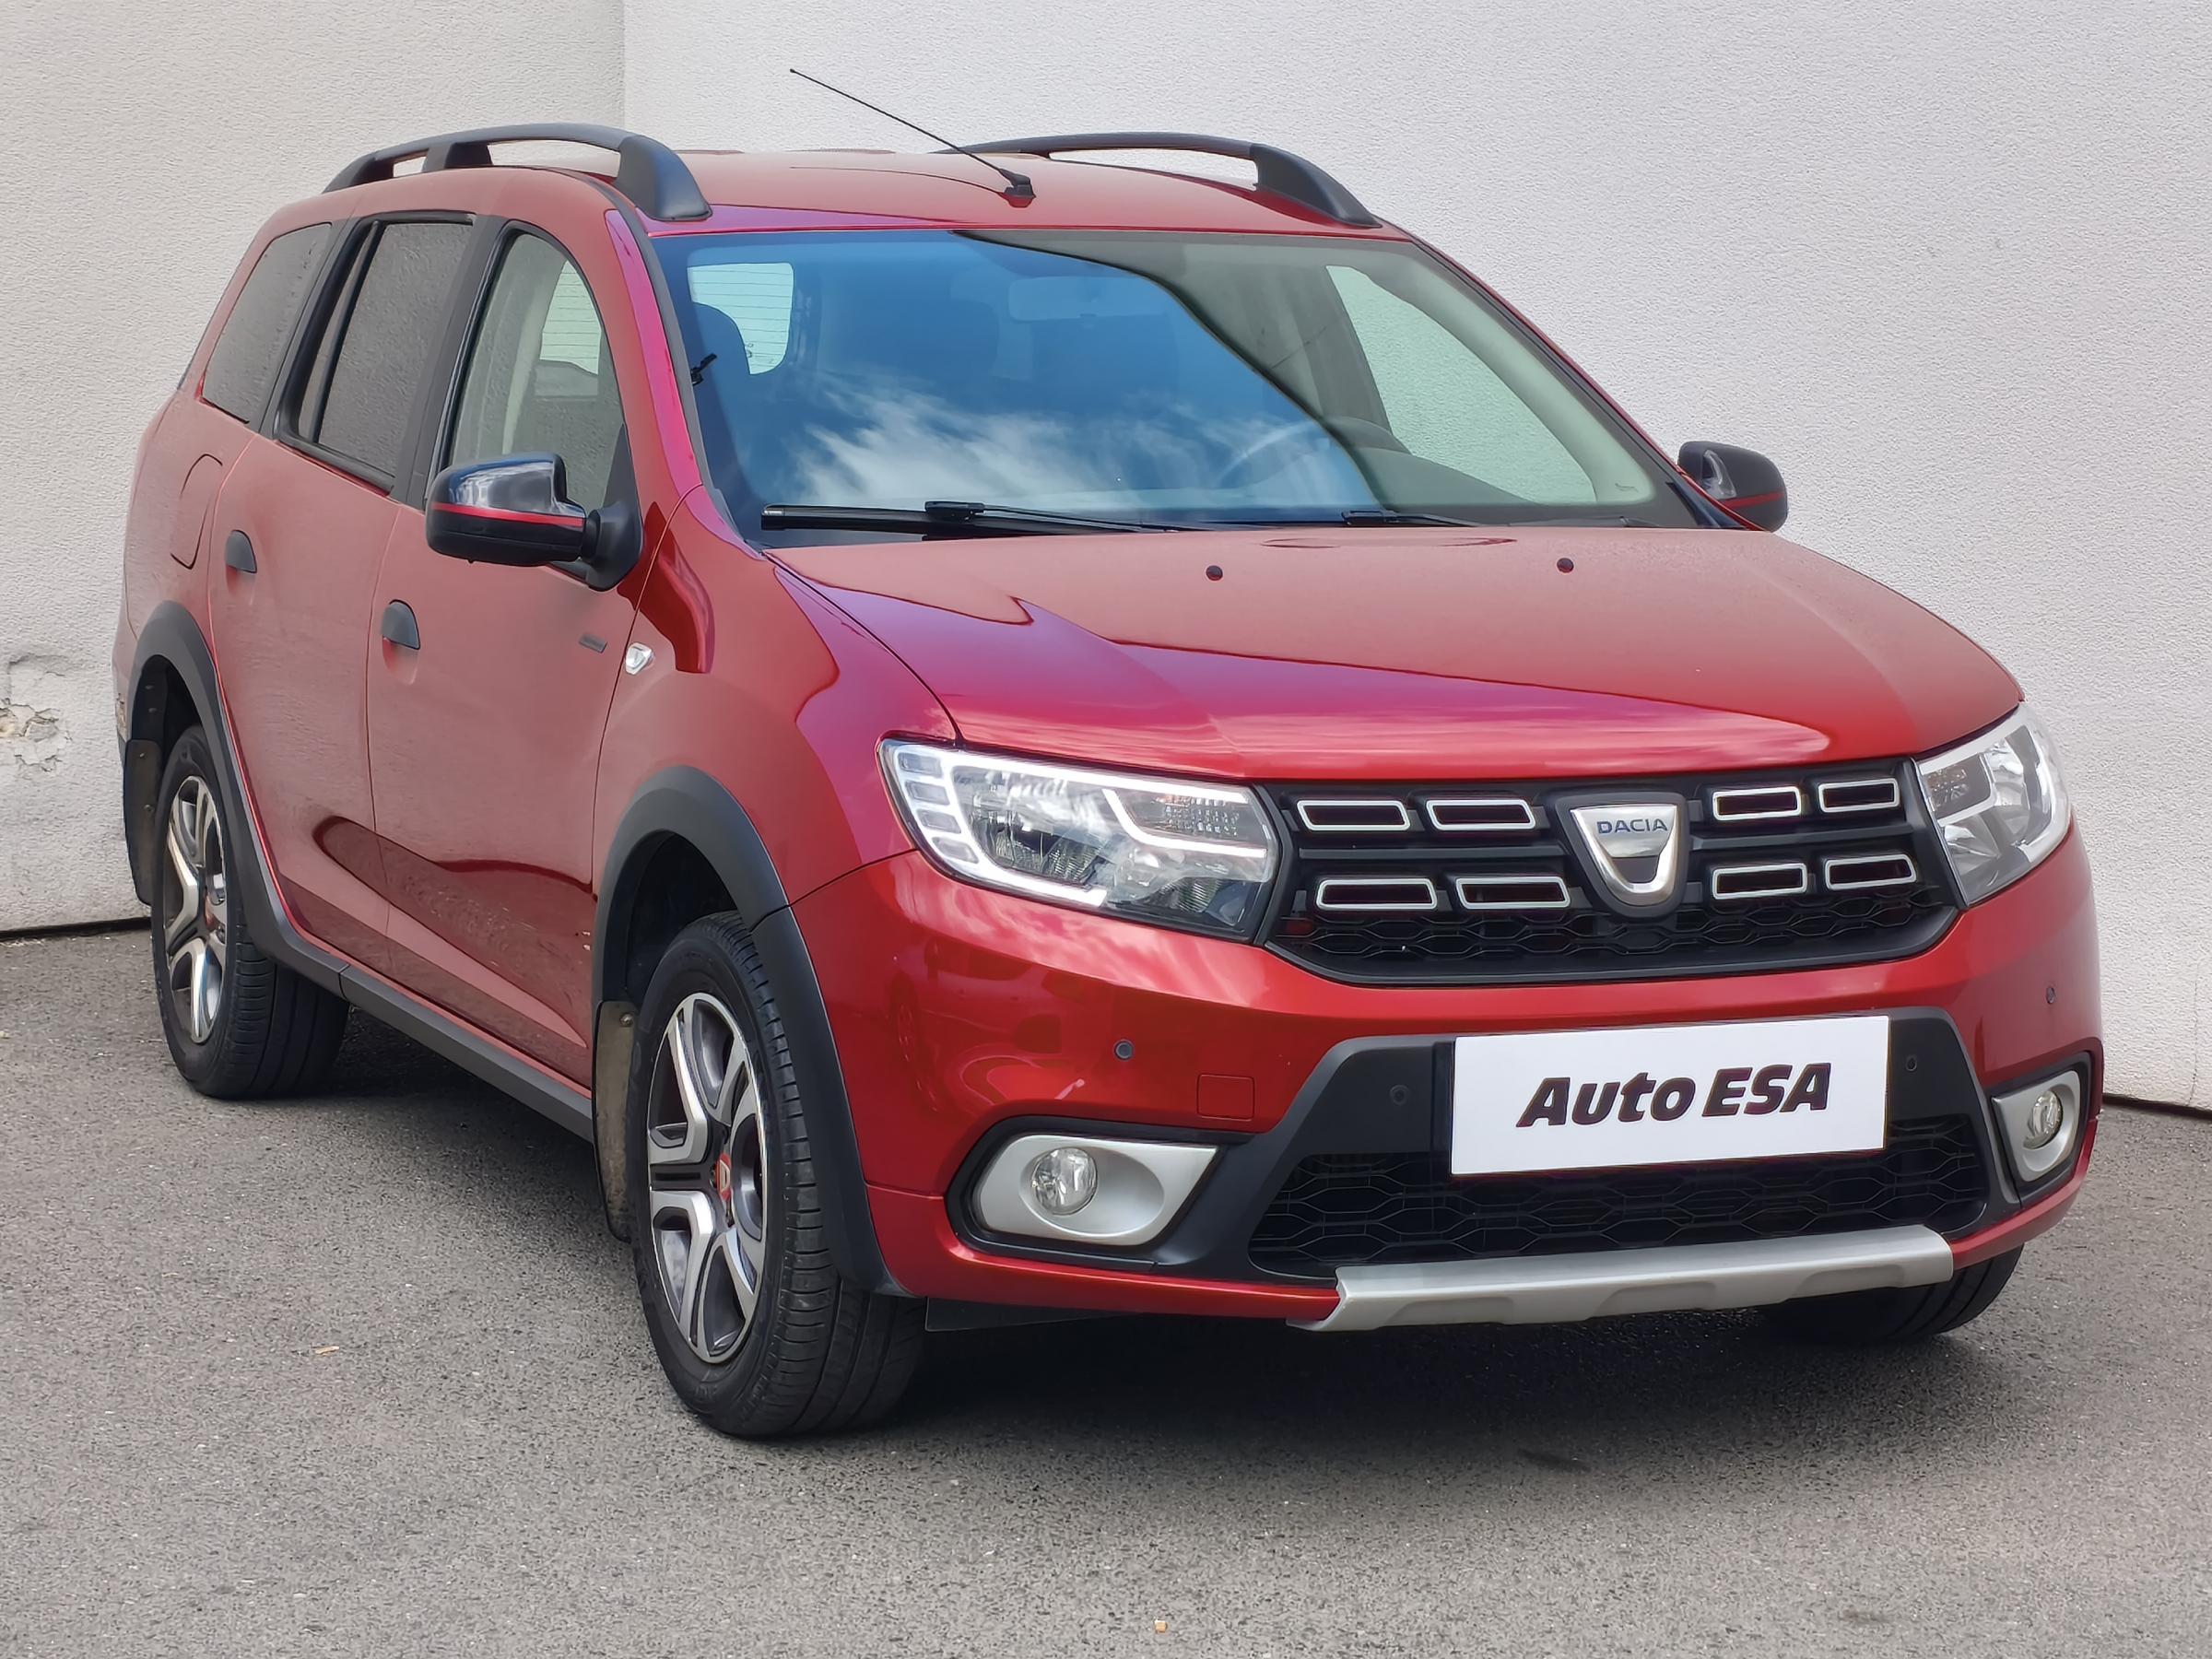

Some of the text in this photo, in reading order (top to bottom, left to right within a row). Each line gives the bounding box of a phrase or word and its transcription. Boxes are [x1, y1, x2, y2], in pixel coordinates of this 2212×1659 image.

[1596, 818, 1668, 834] DACIA
[1515, 1063, 1831, 1128] Auto ESA
